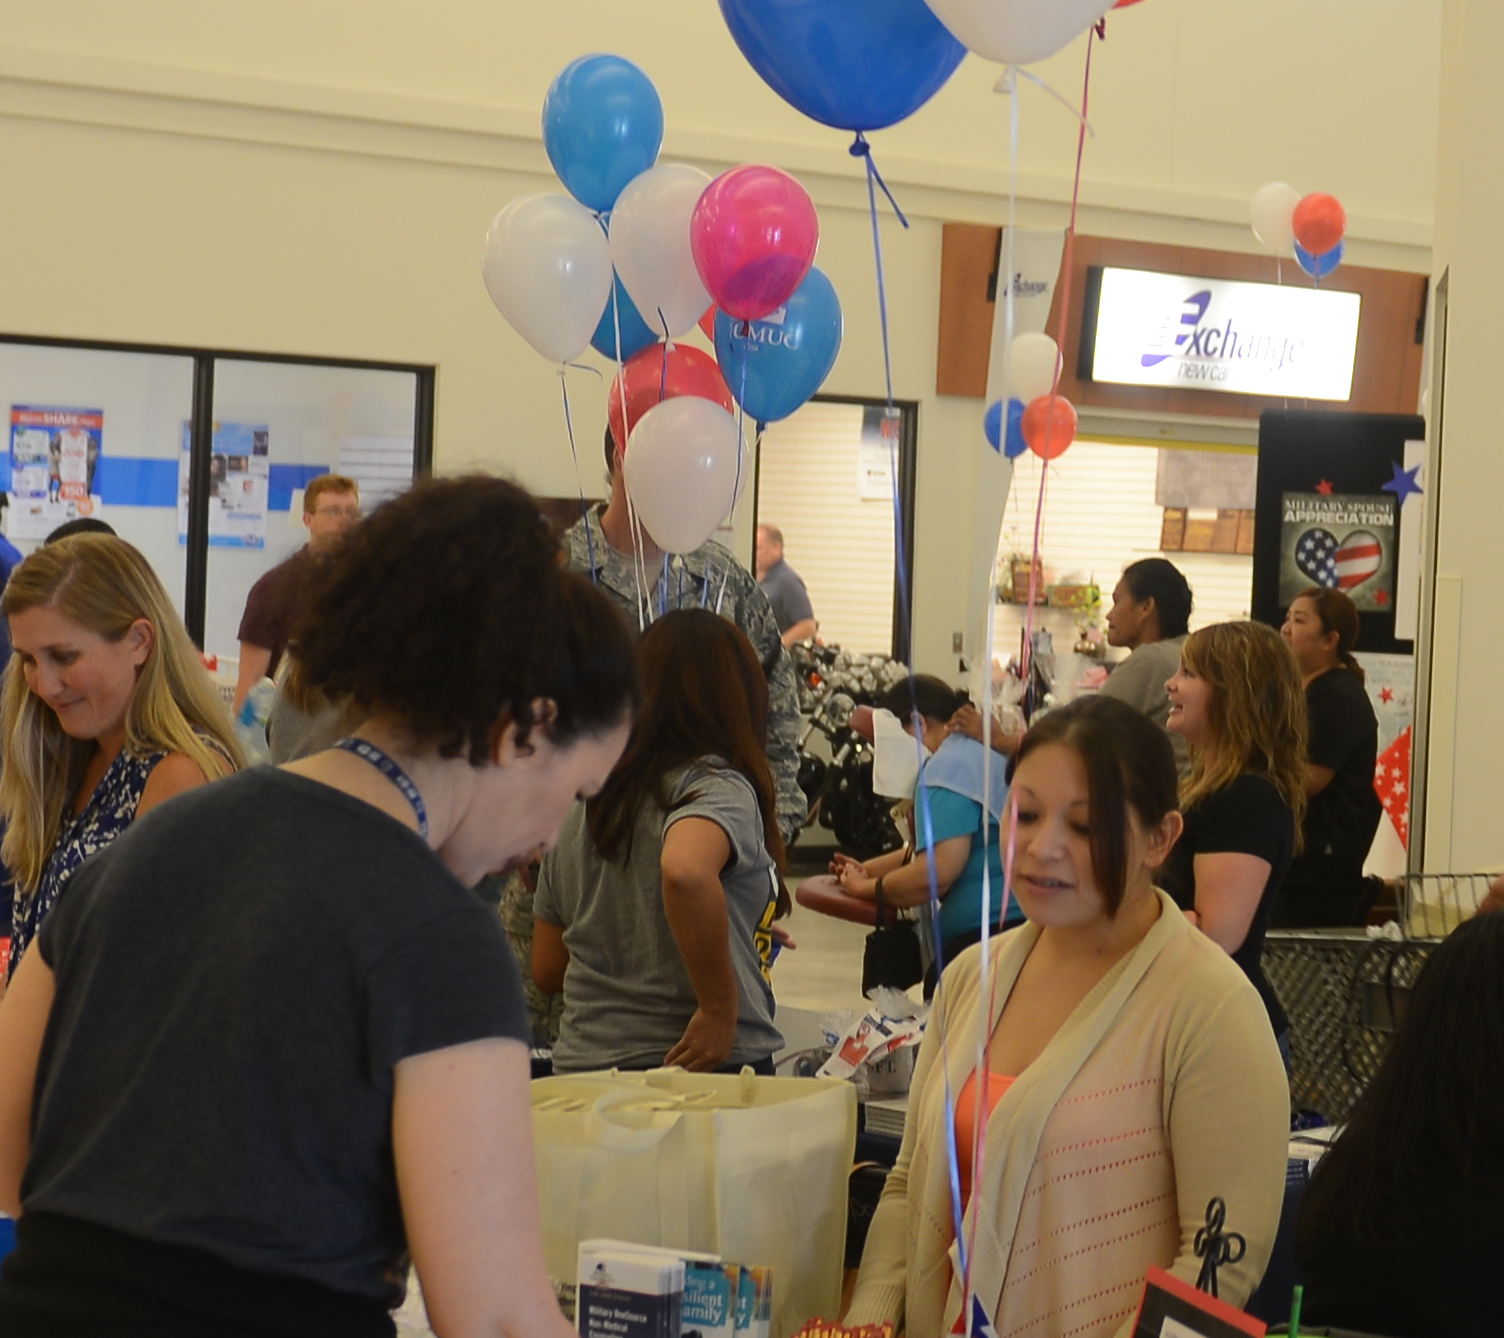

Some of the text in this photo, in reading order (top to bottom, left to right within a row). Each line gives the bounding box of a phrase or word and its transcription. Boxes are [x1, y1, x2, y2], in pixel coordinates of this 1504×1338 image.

[1177, 361, 1210, 379] new
[1285, 500, 1394, 513] MILITARY SPOUSE
[1284, 509, 1394, 526] APPRECIATION
[683, 1306, 723, 1326] amily
